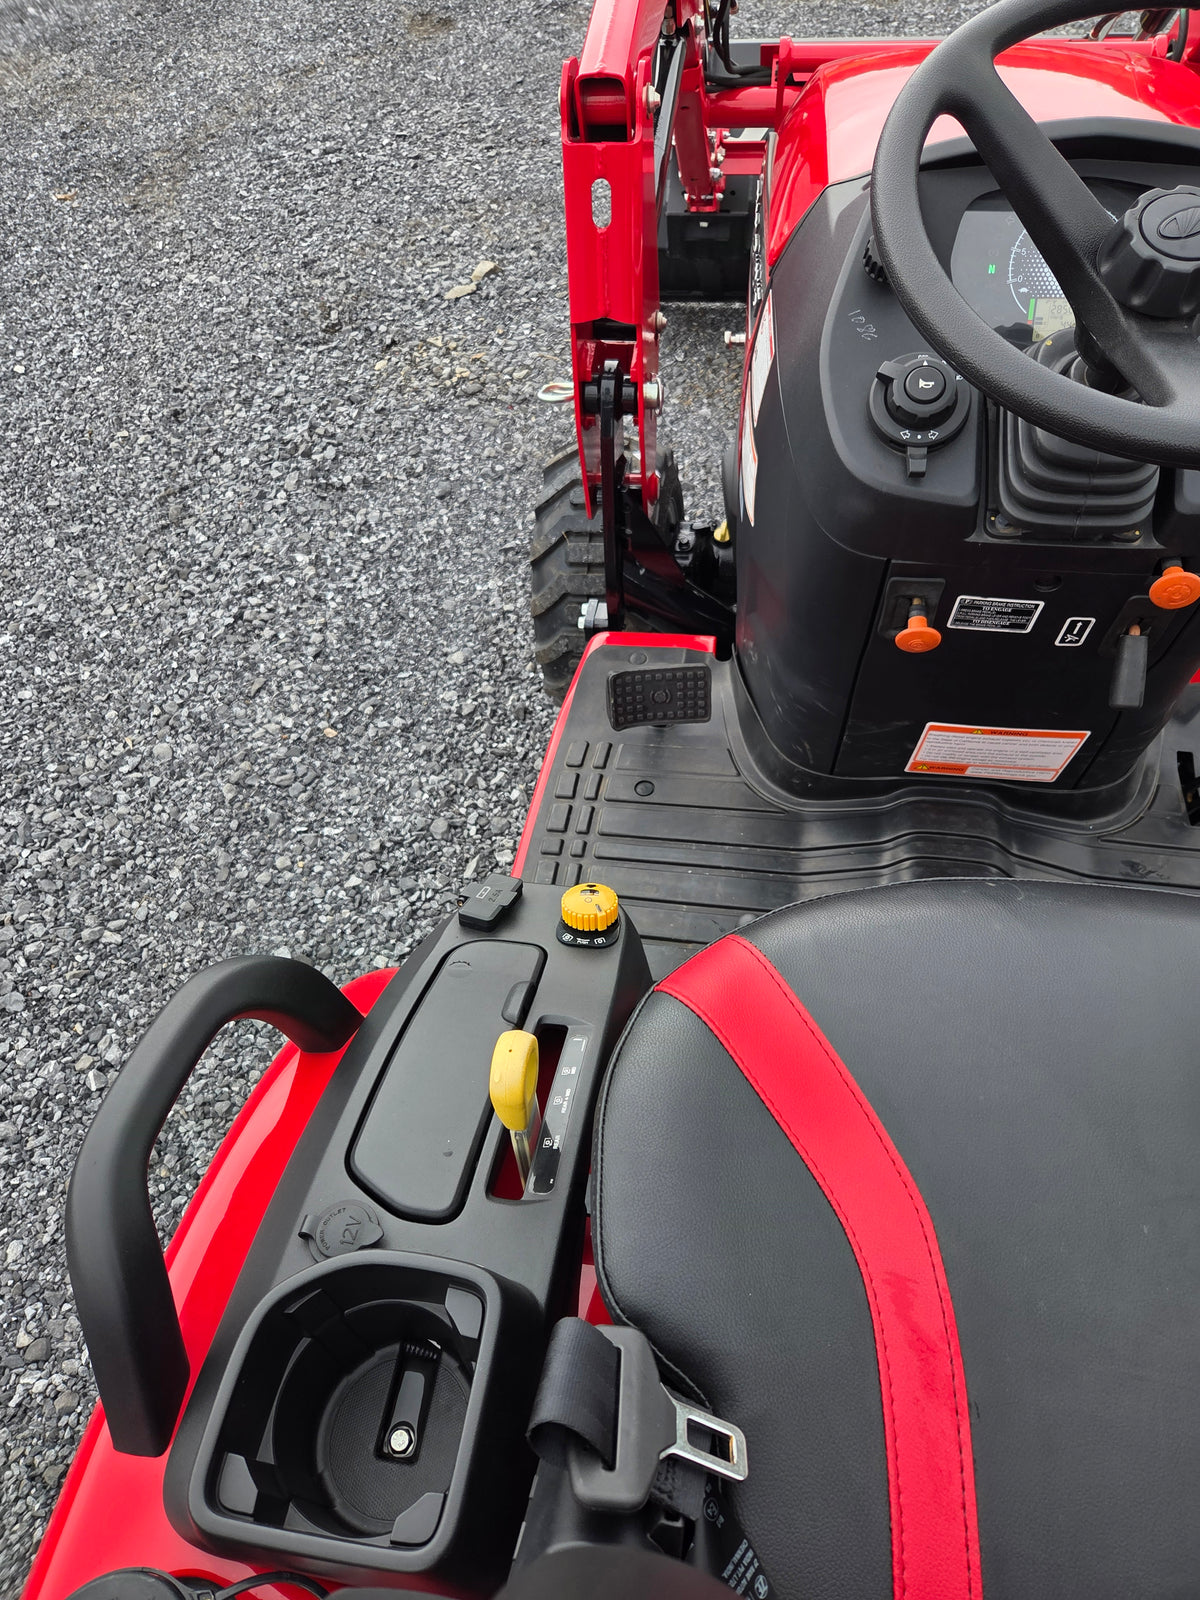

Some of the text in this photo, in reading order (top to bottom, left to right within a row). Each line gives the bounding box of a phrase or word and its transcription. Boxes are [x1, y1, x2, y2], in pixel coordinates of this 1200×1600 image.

[988, 264, 996, 274] N
[322, 1207, 347, 1226] OUTLET
[339, 1215, 362, 1245] 12V
